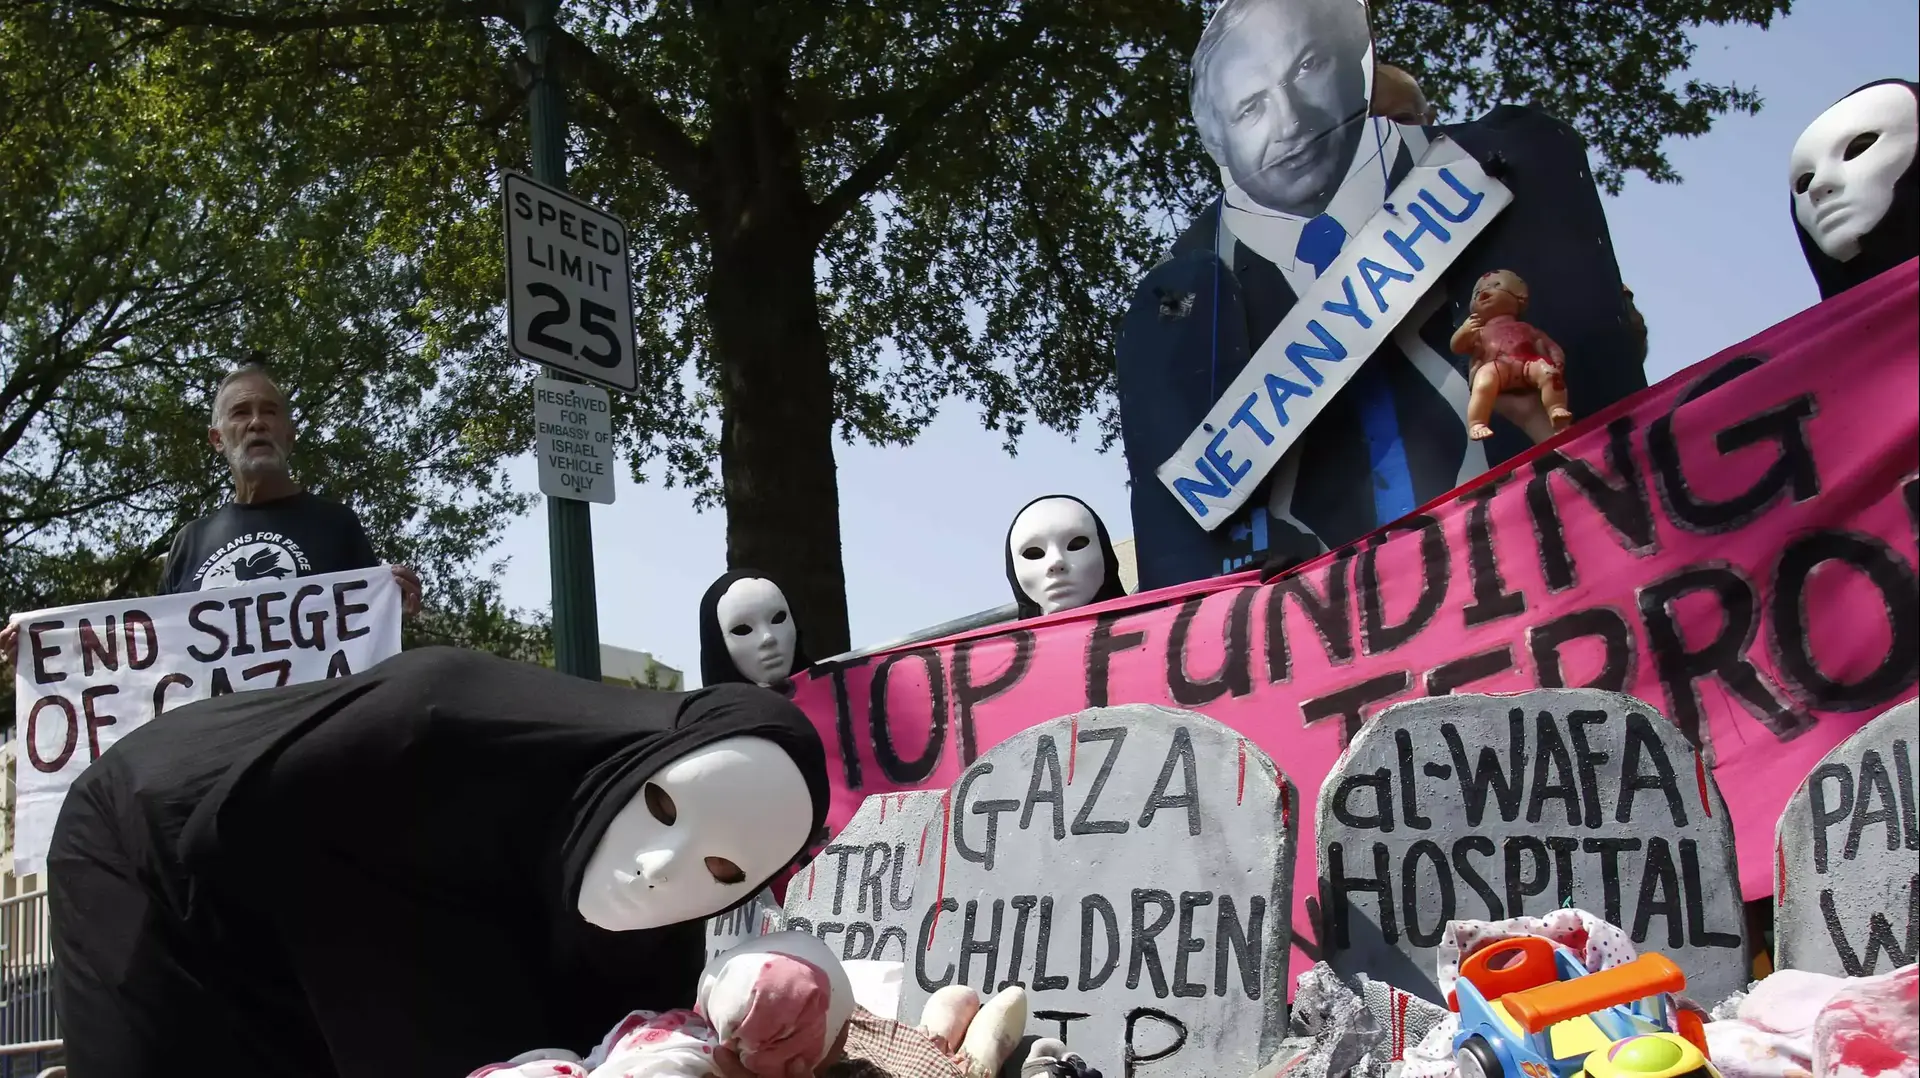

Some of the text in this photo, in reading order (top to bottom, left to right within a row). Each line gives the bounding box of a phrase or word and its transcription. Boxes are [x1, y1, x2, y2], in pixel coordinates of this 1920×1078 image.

[514, 191, 621, 256] SPEED
[527, 236, 612, 292] LIMIT
[526, 282, 622, 369] 25
[1173, 168, 1485, 517] NETANYAHU
[538, 389, 607, 413] RESERVED
[539, 422, 609, 444] EMBASSY OF
[560, 409, 587, 426] FOR
[549, 454, 604, 476] VEHICLE
[552, 438, 598, 458] ISRAEL
[561, 472, 593, 490] ONLY
[193, 531, 311, 582] VETERANS FOR PEACE
[1084, 354, 1820, 707] FUNDING
[29, 609, 158, 685] END
[187, 579, 370, 663] SIEGE
[26, 684, 120, 773] OF
[953, 726, 1202, 871] GAZA
[1327, 835, 1741, 950] HOSPITAL
[915, 887, 1265, 1000] CHILDREN
